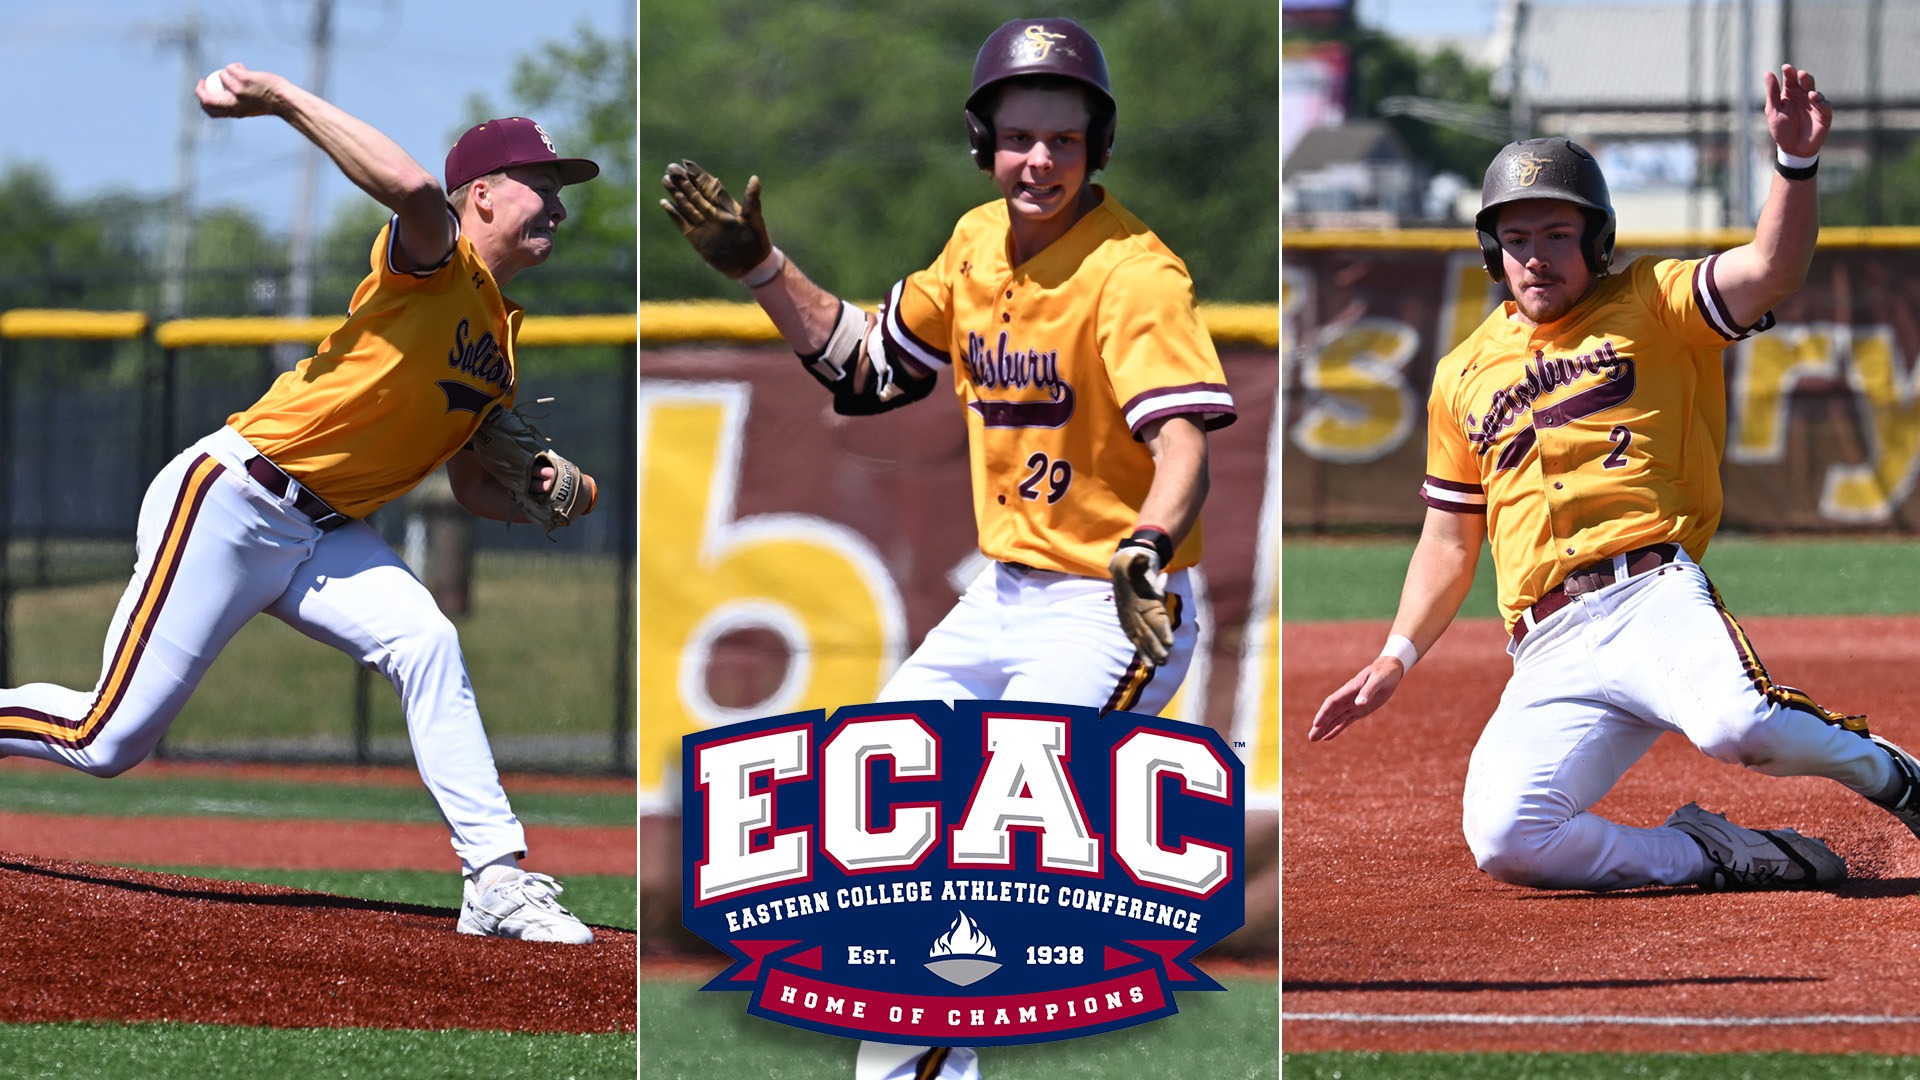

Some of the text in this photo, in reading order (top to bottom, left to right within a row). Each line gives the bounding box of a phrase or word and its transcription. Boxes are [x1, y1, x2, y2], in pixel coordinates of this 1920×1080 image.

[968, 330, 1068, 404] lisbury
[1602, 424, 1633, 470] 2
[556, 464, 573, 502] Wilson
[1018, 451, 1073, 506] 29
